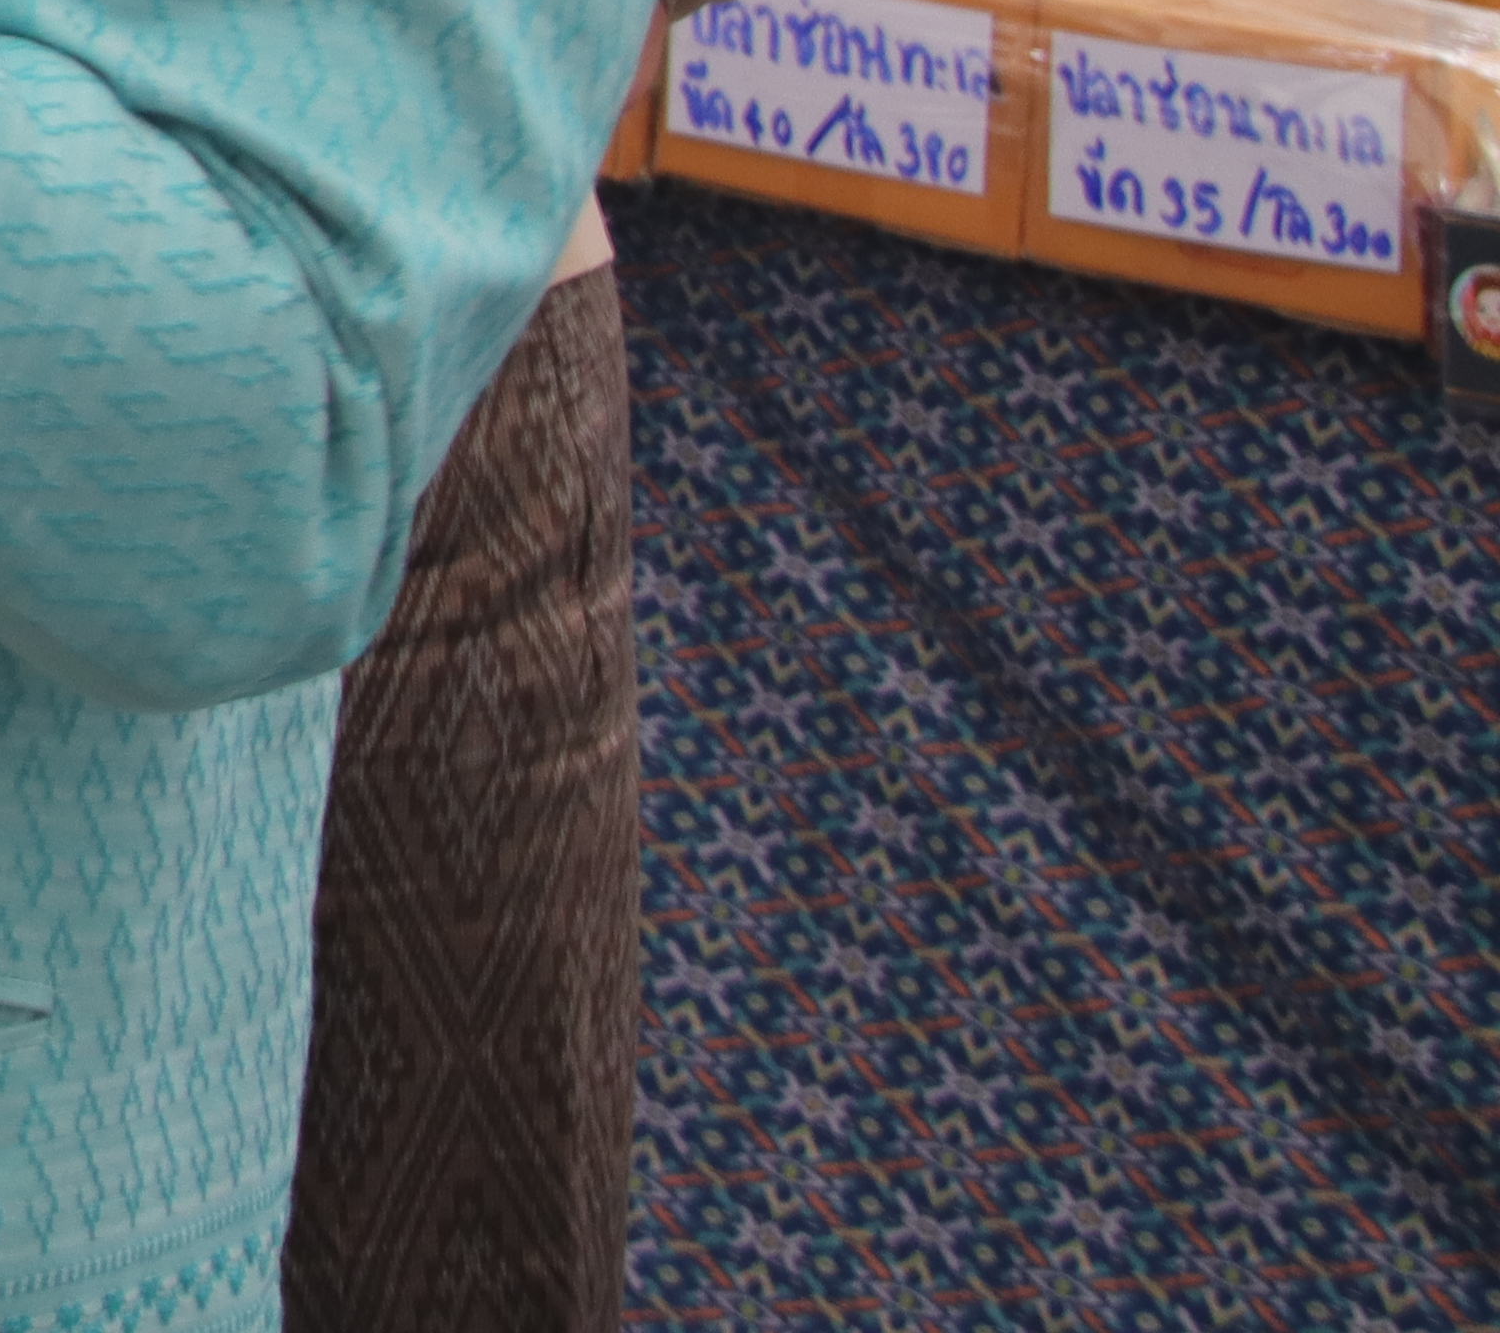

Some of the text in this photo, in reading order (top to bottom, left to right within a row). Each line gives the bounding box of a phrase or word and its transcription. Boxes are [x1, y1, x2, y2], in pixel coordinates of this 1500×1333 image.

[1058, 50, 1386, 167] ปลาช่อนทะเล
[1075, 136, 1145, 217] ขีด
[1160, 177, 1223, 235] 35
[1320, 201, 1394, 261] 300
